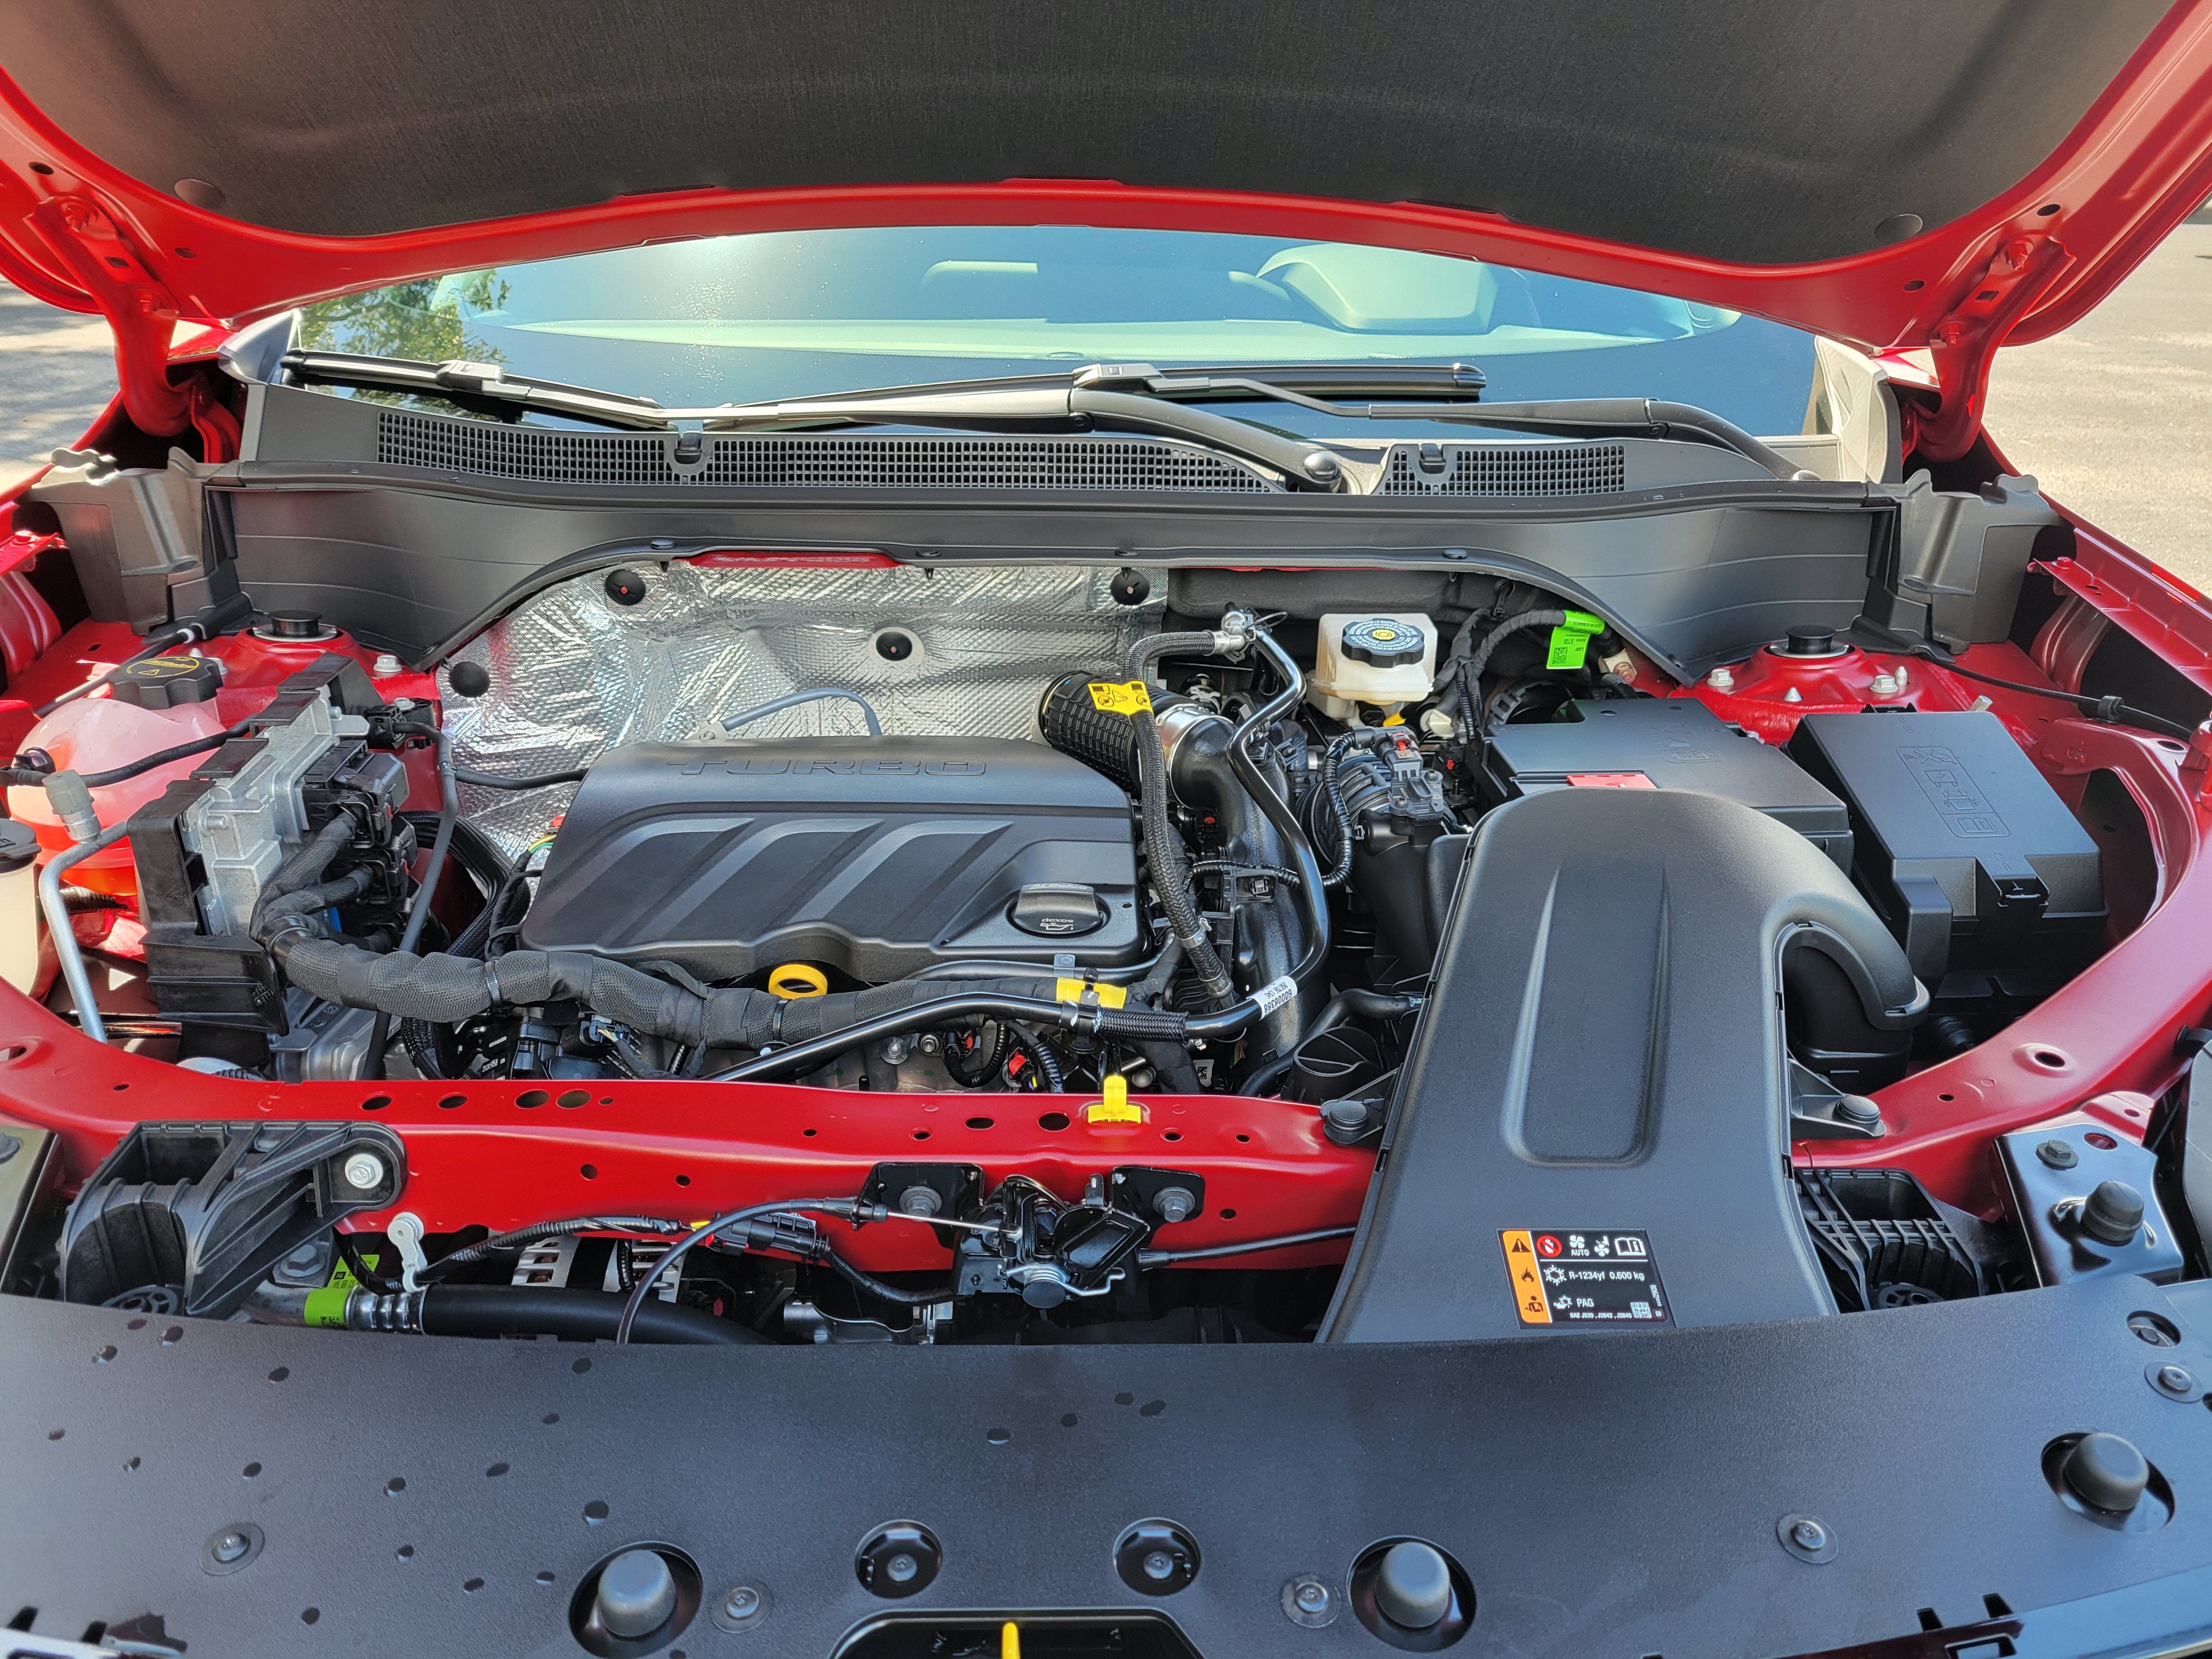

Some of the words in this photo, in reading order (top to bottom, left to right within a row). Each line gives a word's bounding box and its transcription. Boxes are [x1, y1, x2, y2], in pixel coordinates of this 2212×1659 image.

[667, 759, 986, 776] TURBO
[1263, 989, 1293, 1013] 60008388
[1571, 1249, 1590, 1257] AUTO
[1568, 1271, 1605, 1282] R-1234yf
[1609, 1271, 1632, 1280] 0.600
[1633, 1271, 1645, 1282] kg
[1576, 1298, 1595, 1308] PAG
